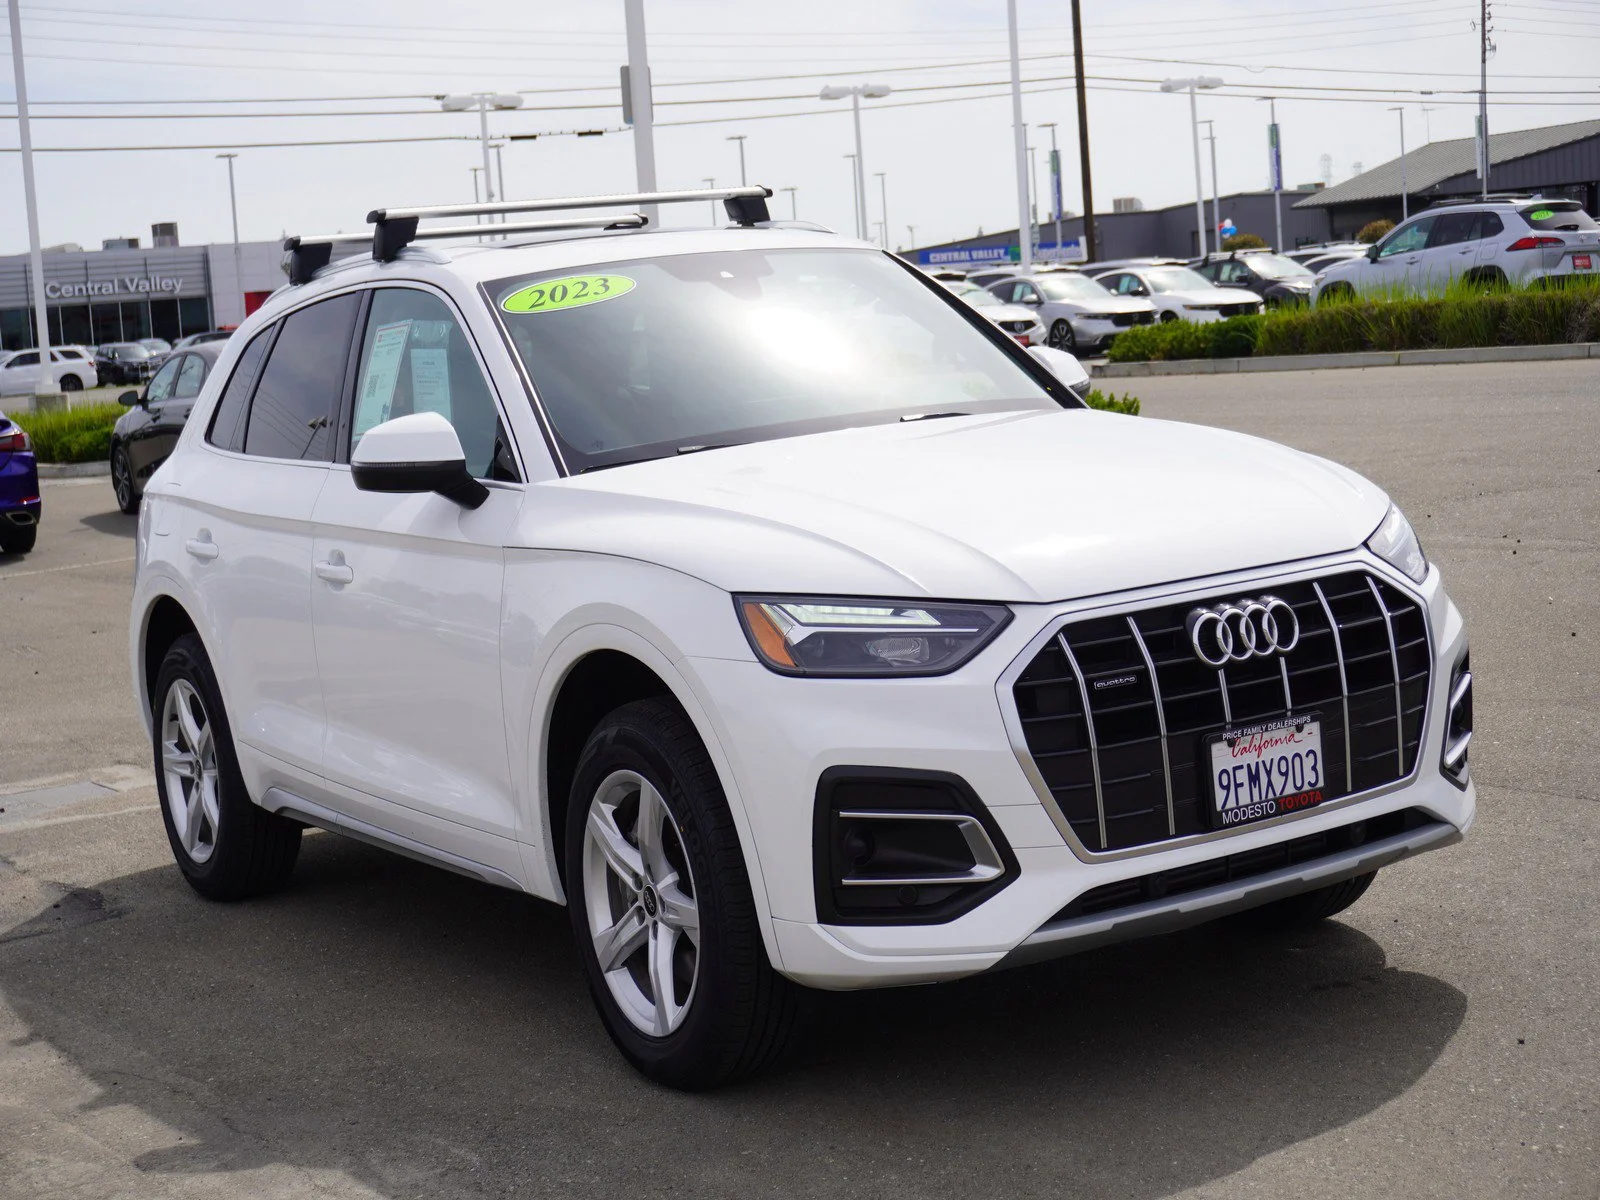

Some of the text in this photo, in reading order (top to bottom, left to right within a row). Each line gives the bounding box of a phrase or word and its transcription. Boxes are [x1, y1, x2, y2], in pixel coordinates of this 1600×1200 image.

[929, 248, 1005, 263] CENTRAL VALLEY
[46, 276, 183, 298] Central Valley
[528, 277, 610, 309] 2023
[1096, 676, 1136, 688] quattro
[1222, 715, 1311, 741] PRICE FAMILY DEALERSHIPS
[1231, 731, 1303, 758] California
[1218, 749, 1319, 810] 9FMX903
[1222, 791, 1323, 824] MODESTO TOYOTA
